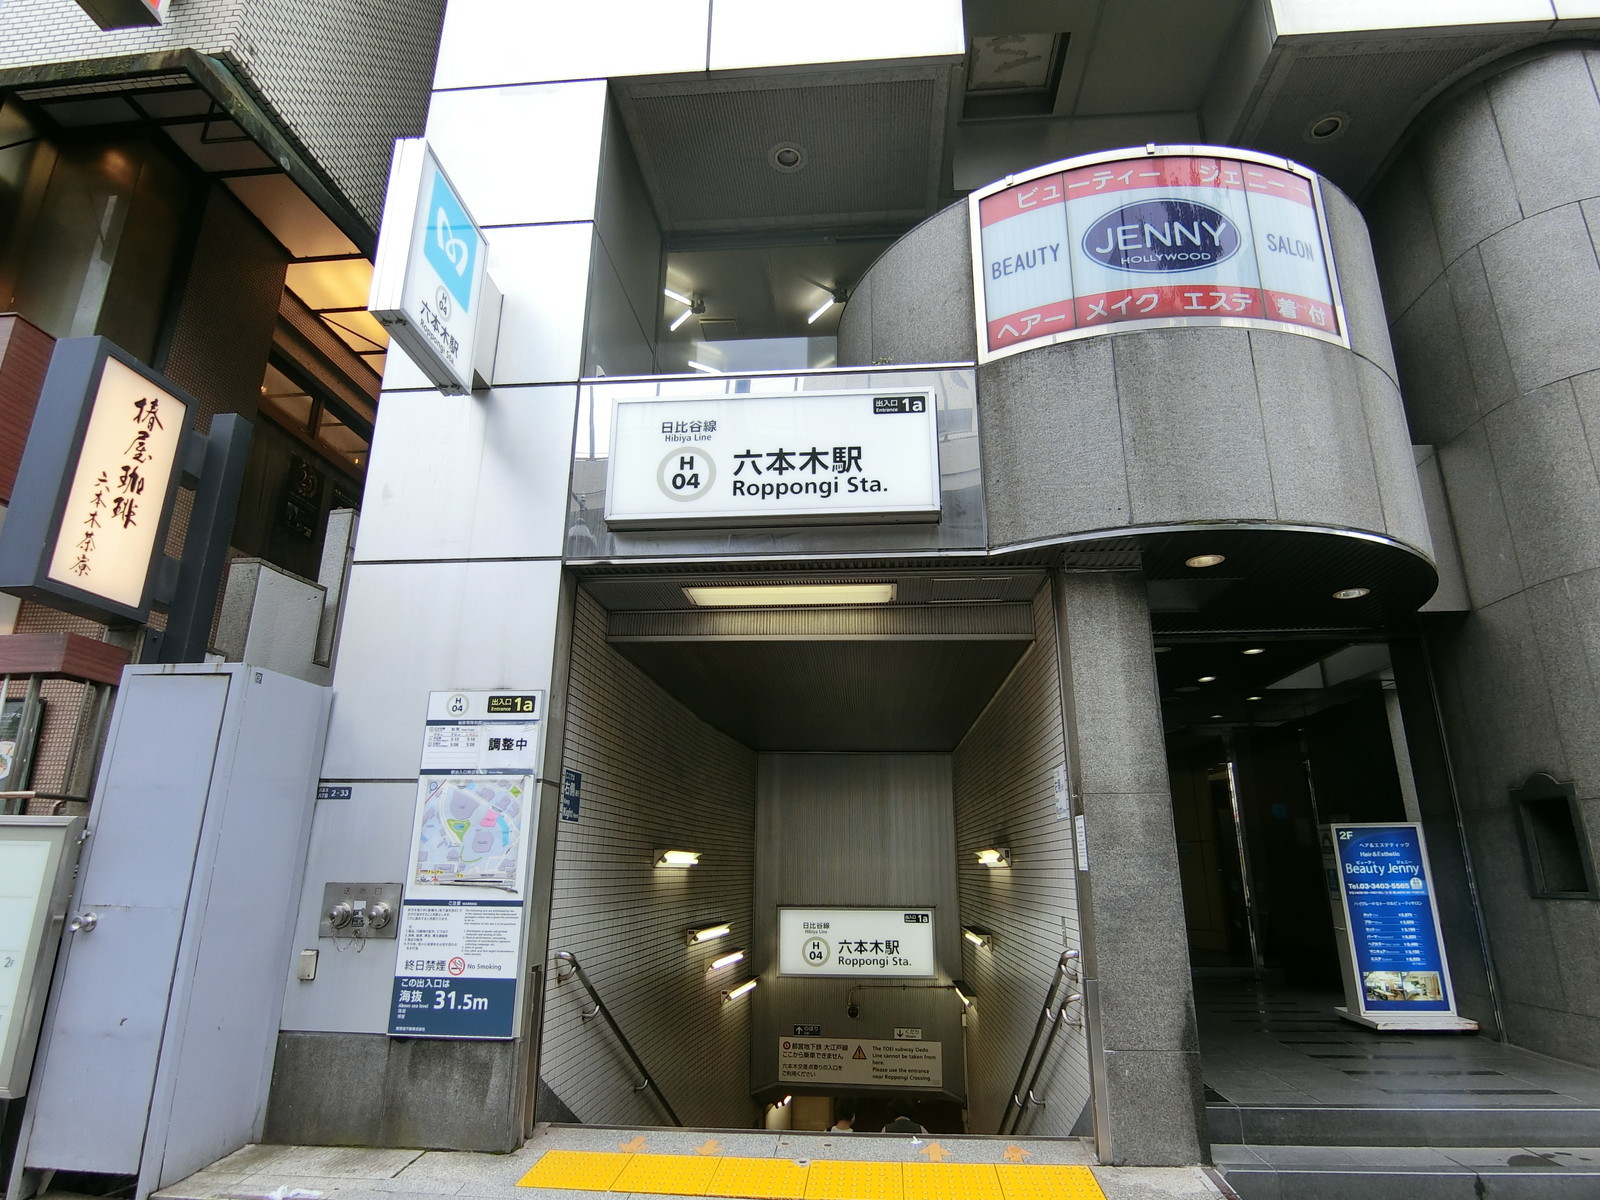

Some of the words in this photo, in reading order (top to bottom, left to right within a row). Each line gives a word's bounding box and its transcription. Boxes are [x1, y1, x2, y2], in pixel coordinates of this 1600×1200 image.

[1018, 170, 1160, 209] ビューティー
[1096, 221, 1226, 253] JENNY
[1267, 233, 1314, 261] SALON
[992, 243, 1060, 280] BEAUTY
[1121, 252, 1211, 265] HOLLYWOOD
[442, 293, 447, 304] H
[439, 301, 447, 316] 04
[997, 314, 1065, 338] ヘアー
[1087, 293, 1158, 320] メイク
[1184, 292, 1252, 311] エステ
[1277, 297, 1325, 326] 着付
[420, 300, 459, 359] 六本木駅
[420, 319, 445, 354] Roppongi
[875, 399, 898, 407] 出入口
[901, 398, 923, 412] 1a
[661, 420, 717, 434] 日比谷線
[665, 434, 692, 444] Hibiya
[694, 433, 712, 441] Line
[680, 456, 694, 470] H
[733, 446, 863, 476] 六本木駅
[672, 473, 700, 490] 04
[733, 477, 838, 500] Roppongi
[847, 476, 888, 493] Sta.
[491, 698, 512, 706] 出入口
[514, 697, 533, 712] 1a
[488, 737, 528, 751] 調整中
[1339, 831, 1353, 840] 2F
[1345, 863, 1385, 876] Beauty
[1387, 863, 1419, 876] Jenny
[917, 914, 928, 923] 1a
[803, 922, 830, 930] 日比谷線
[812, 942, 820, 950] H
[838, 939, 900, 955] 六本木駅
[809, 951, 823, 960] 04
[838, 956, 889, 968] Roppongi
[892, 956, 912, 966] Sta.
[405, 959, 446, 972] 終日禁煙
[477, 963, 502, 972] Smoking
[401, 979, 451, 988] この出入口は
[398, 989, 423, 1003] 海抜
[433, 990, 489, 1010] 31.5m
